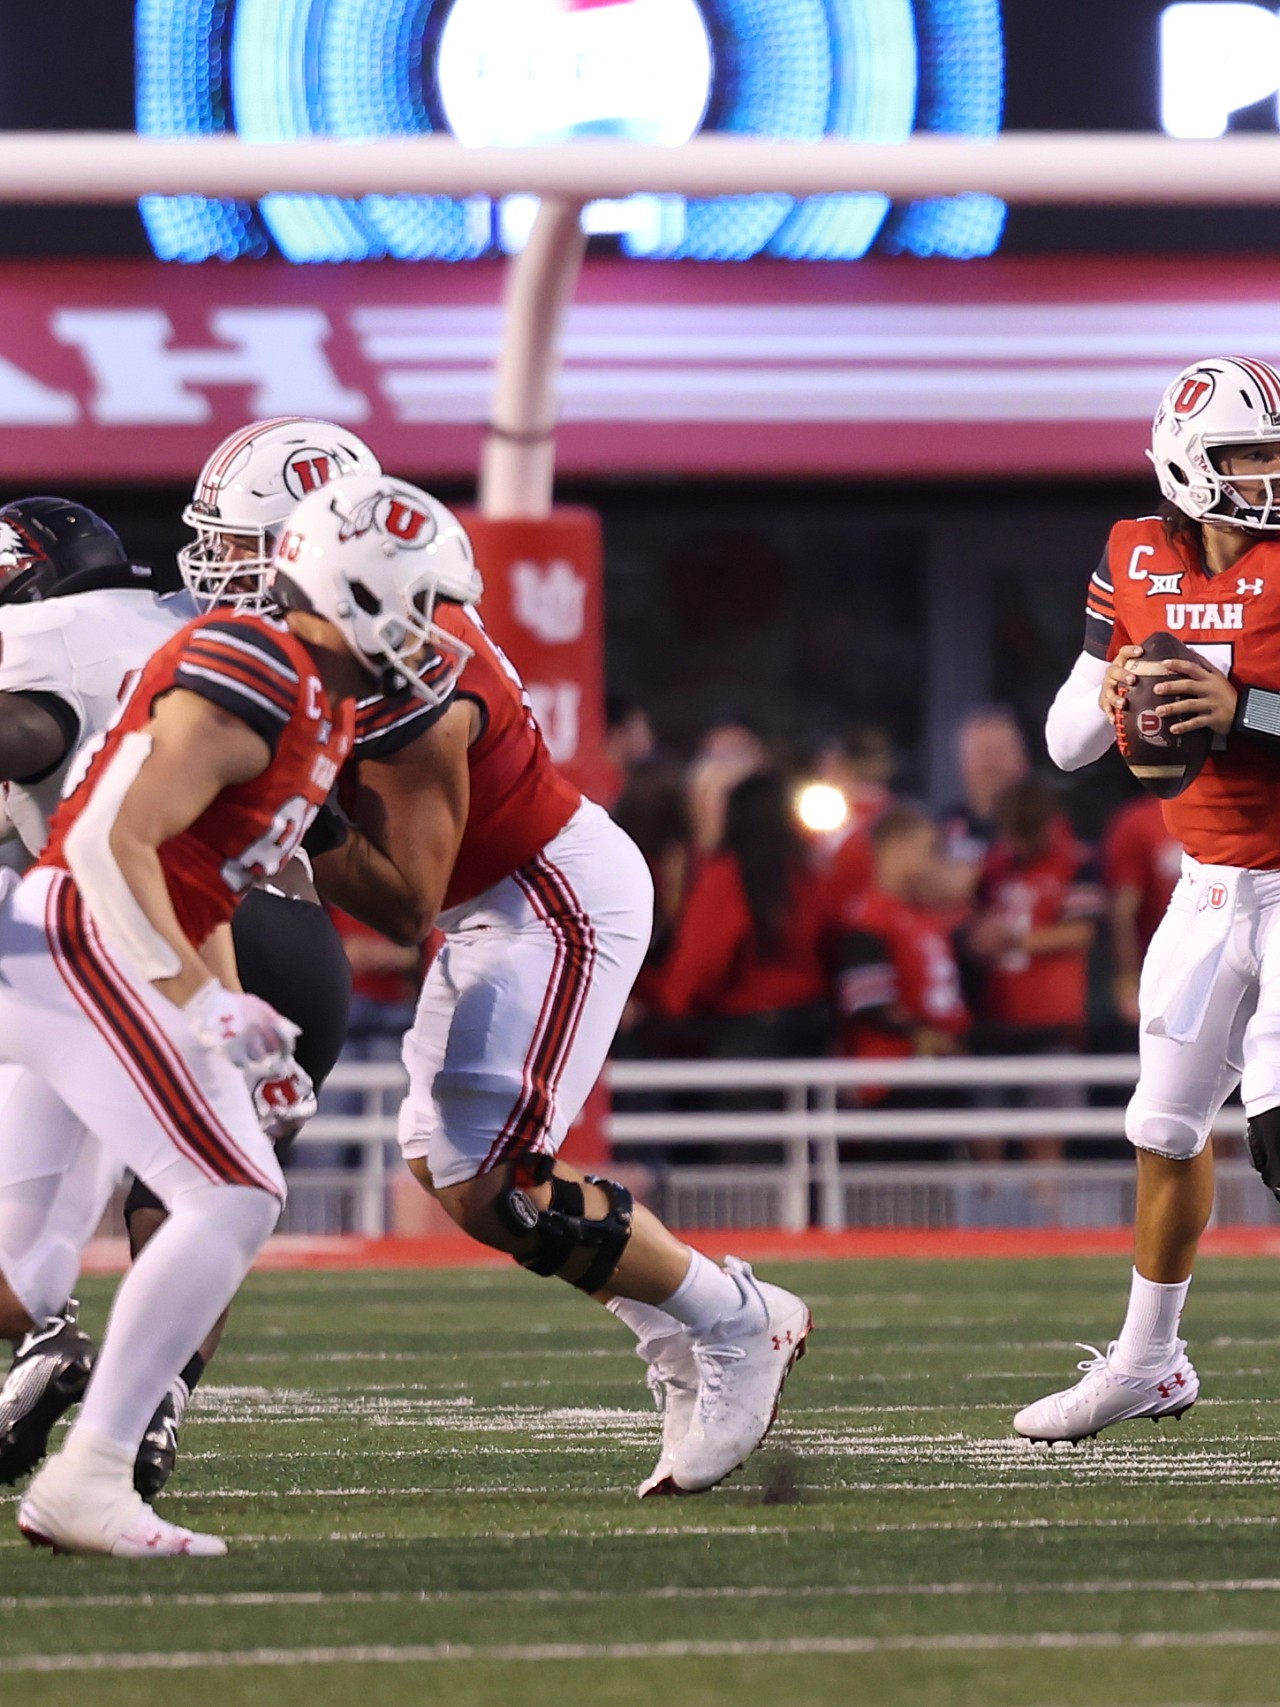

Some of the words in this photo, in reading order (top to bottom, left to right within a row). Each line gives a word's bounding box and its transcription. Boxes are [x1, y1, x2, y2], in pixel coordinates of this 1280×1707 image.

[1174, 379, 1210, 414] U
[385, 500, 427, 541] U
[1128, 544, 1154, 580] C
[1165, 603, 1244, 630] UTAH
